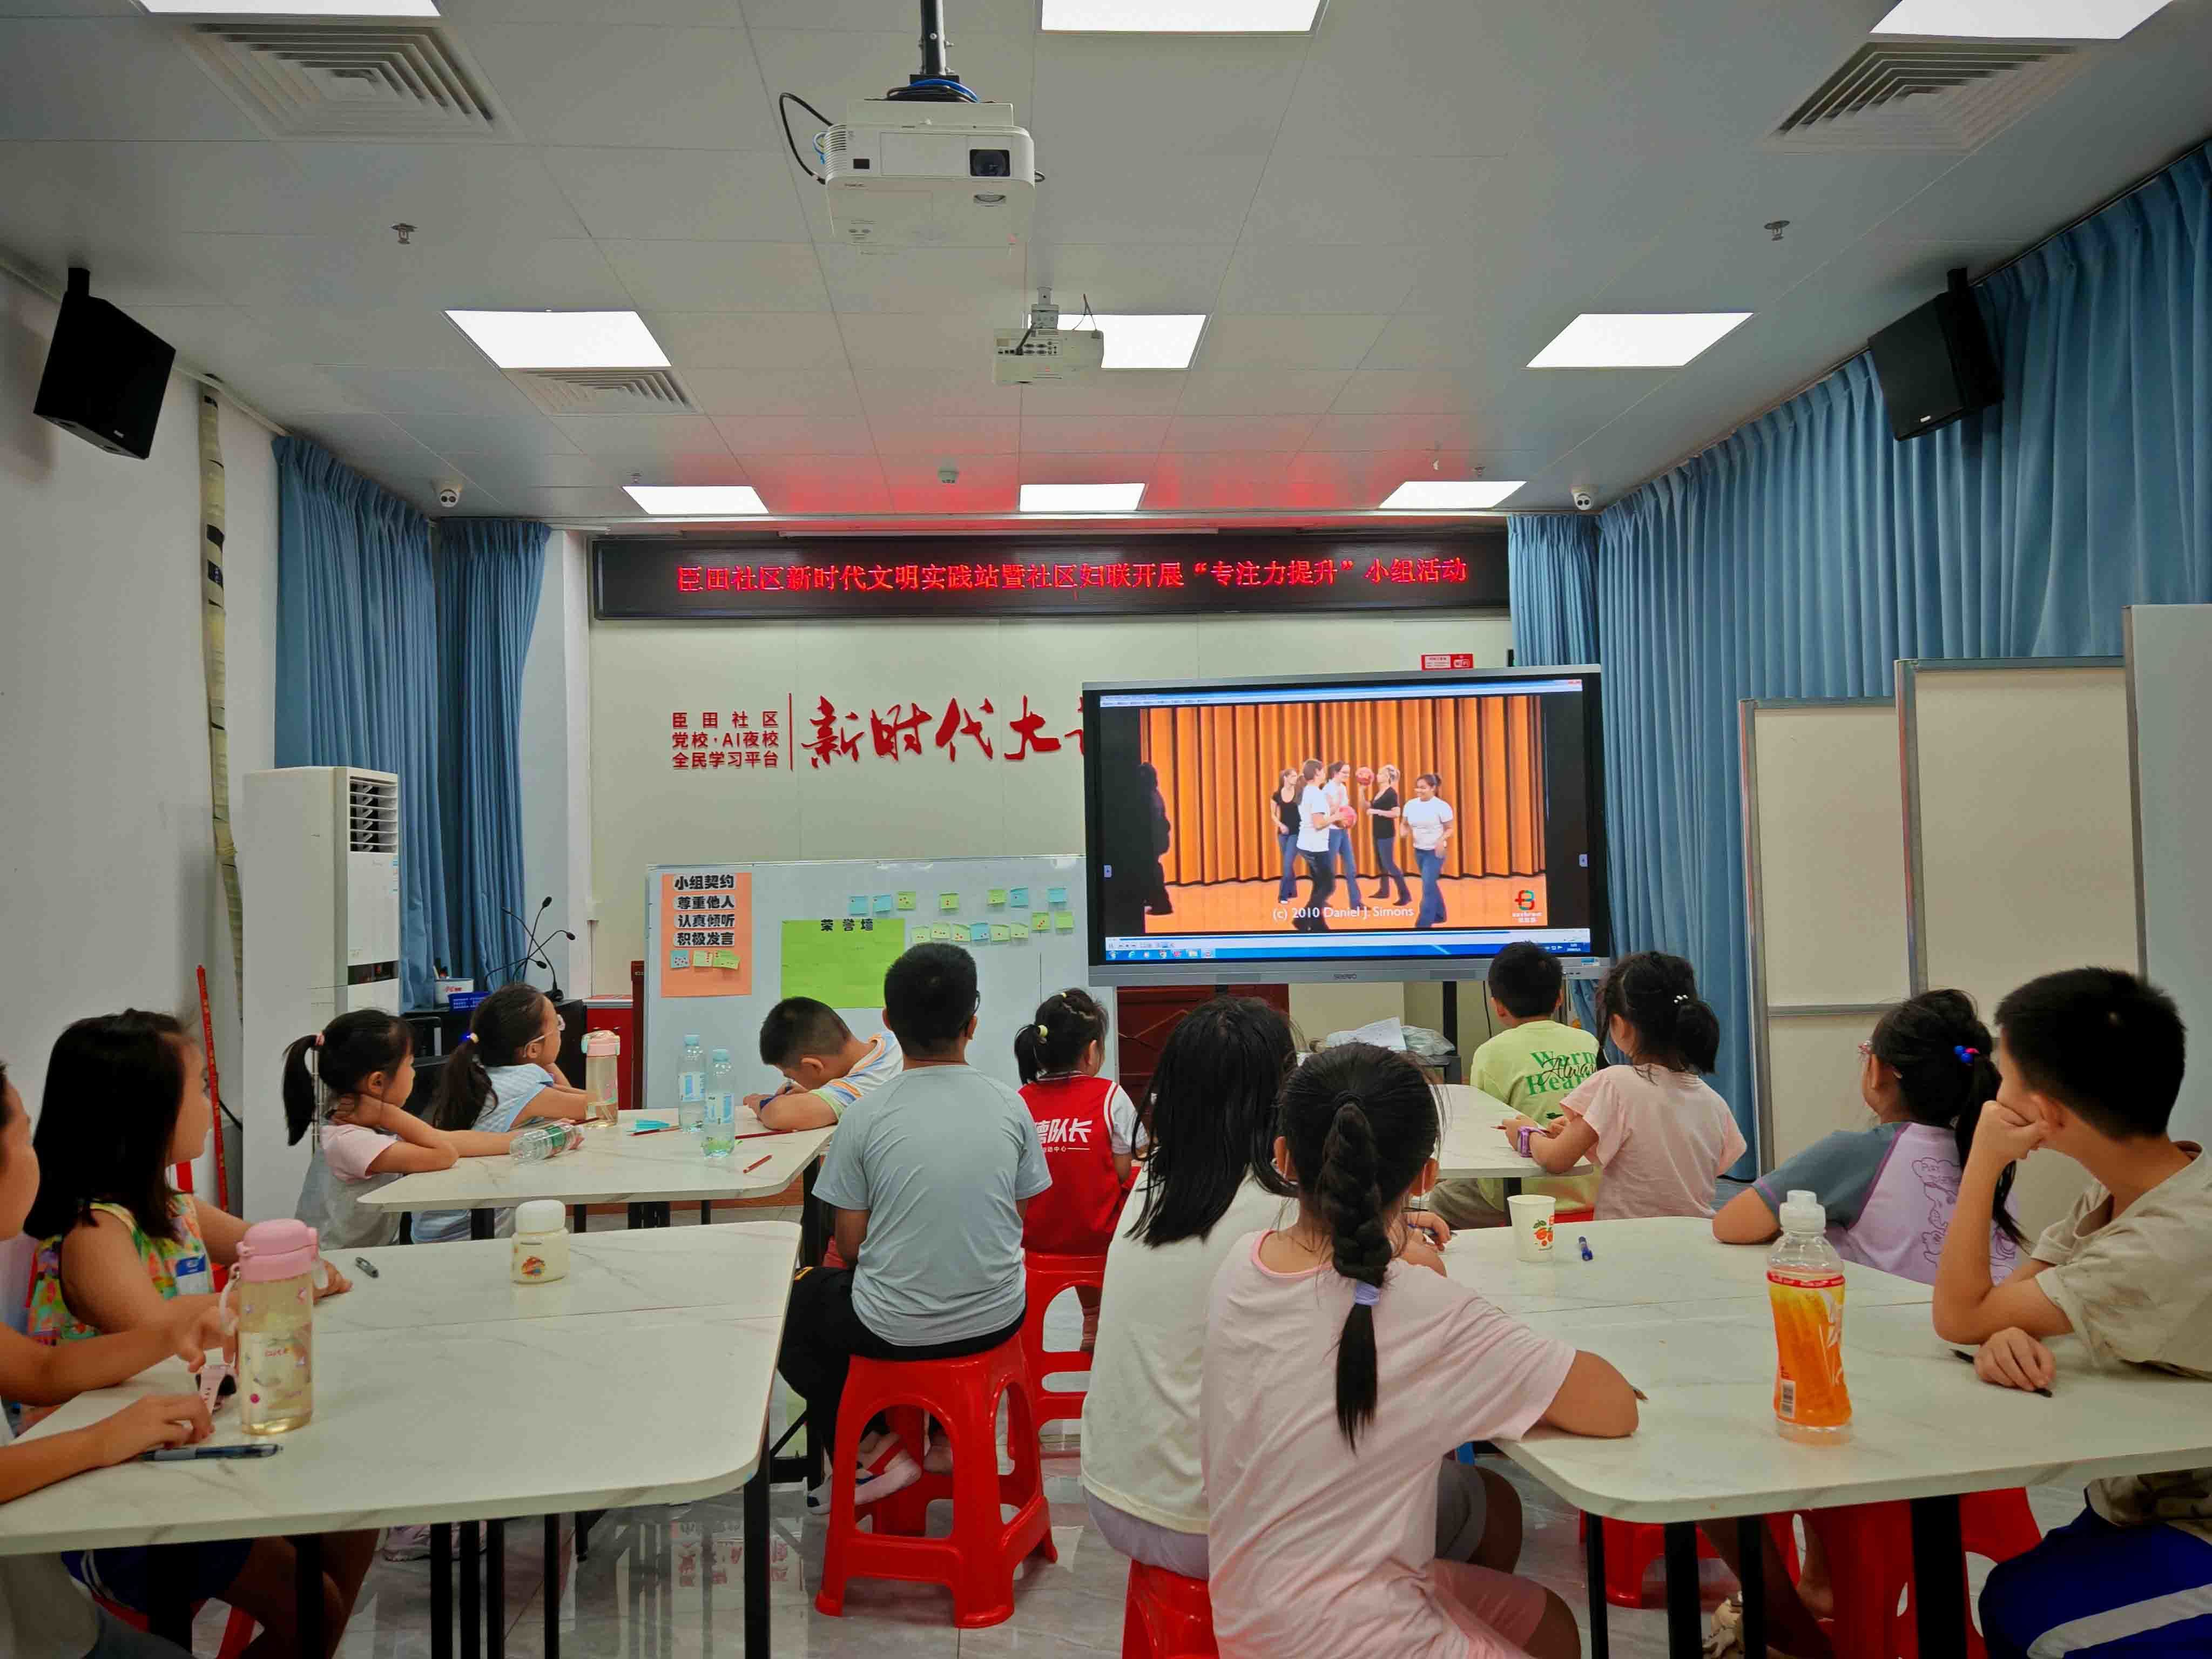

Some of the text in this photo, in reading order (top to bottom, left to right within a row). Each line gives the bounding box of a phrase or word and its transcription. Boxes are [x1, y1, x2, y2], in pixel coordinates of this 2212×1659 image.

[672, 712, 778, 729] 臣田社区
[801, 695, 1083, 767] 新时代大
[673, 751, 778, 768] 全民学习平台
[675, 874, 734, 891] 小组契约
[678, 895, 735, 909] 尊重他人
[678, 913, 735, 928] 认真倾听
[1273, 908, 1287, 920] (c)
[1291, 907, 1320, 918] 2010
[1324, 906, 1360, 918] Daniel
[1373, 906, 1414, 917] Simons
[821, 918, 873, 932] 荣誉墙
[677, 932, 734, 946] 积极发言
